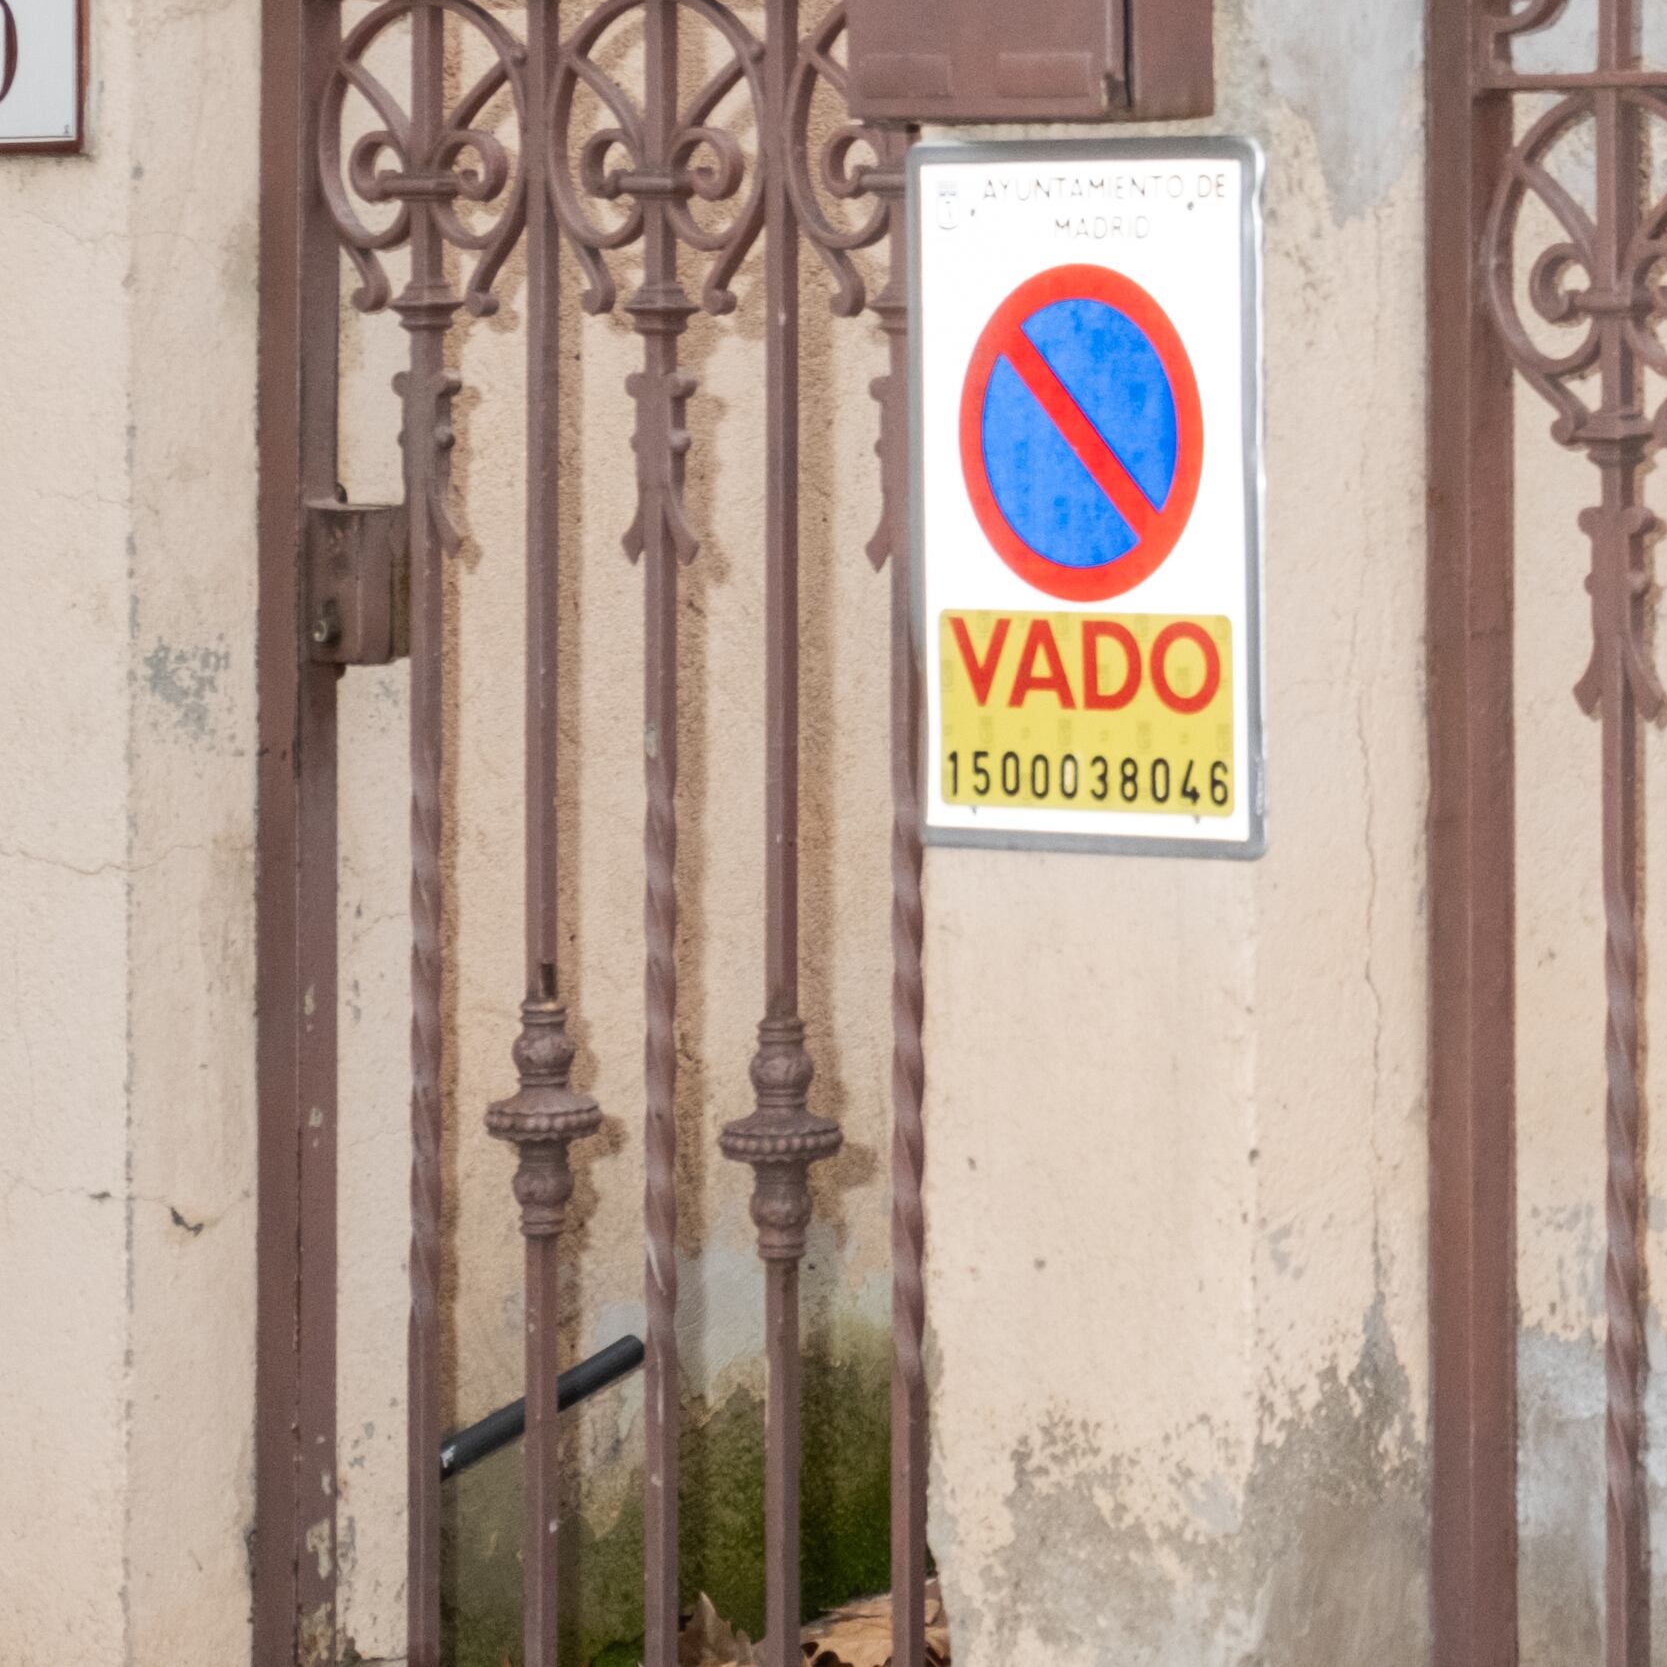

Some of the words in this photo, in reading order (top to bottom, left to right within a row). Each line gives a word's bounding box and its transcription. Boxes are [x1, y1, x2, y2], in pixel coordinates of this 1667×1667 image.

[982, 174, 1184, 201] AYUNTAMIENTO
[1198, 174, 1226, 199] DE
[1055, 215, 1150, 239] MADRID
[948, 616, 1222, 715] VADO
[948, 750, 1229, 807] 1500038046
